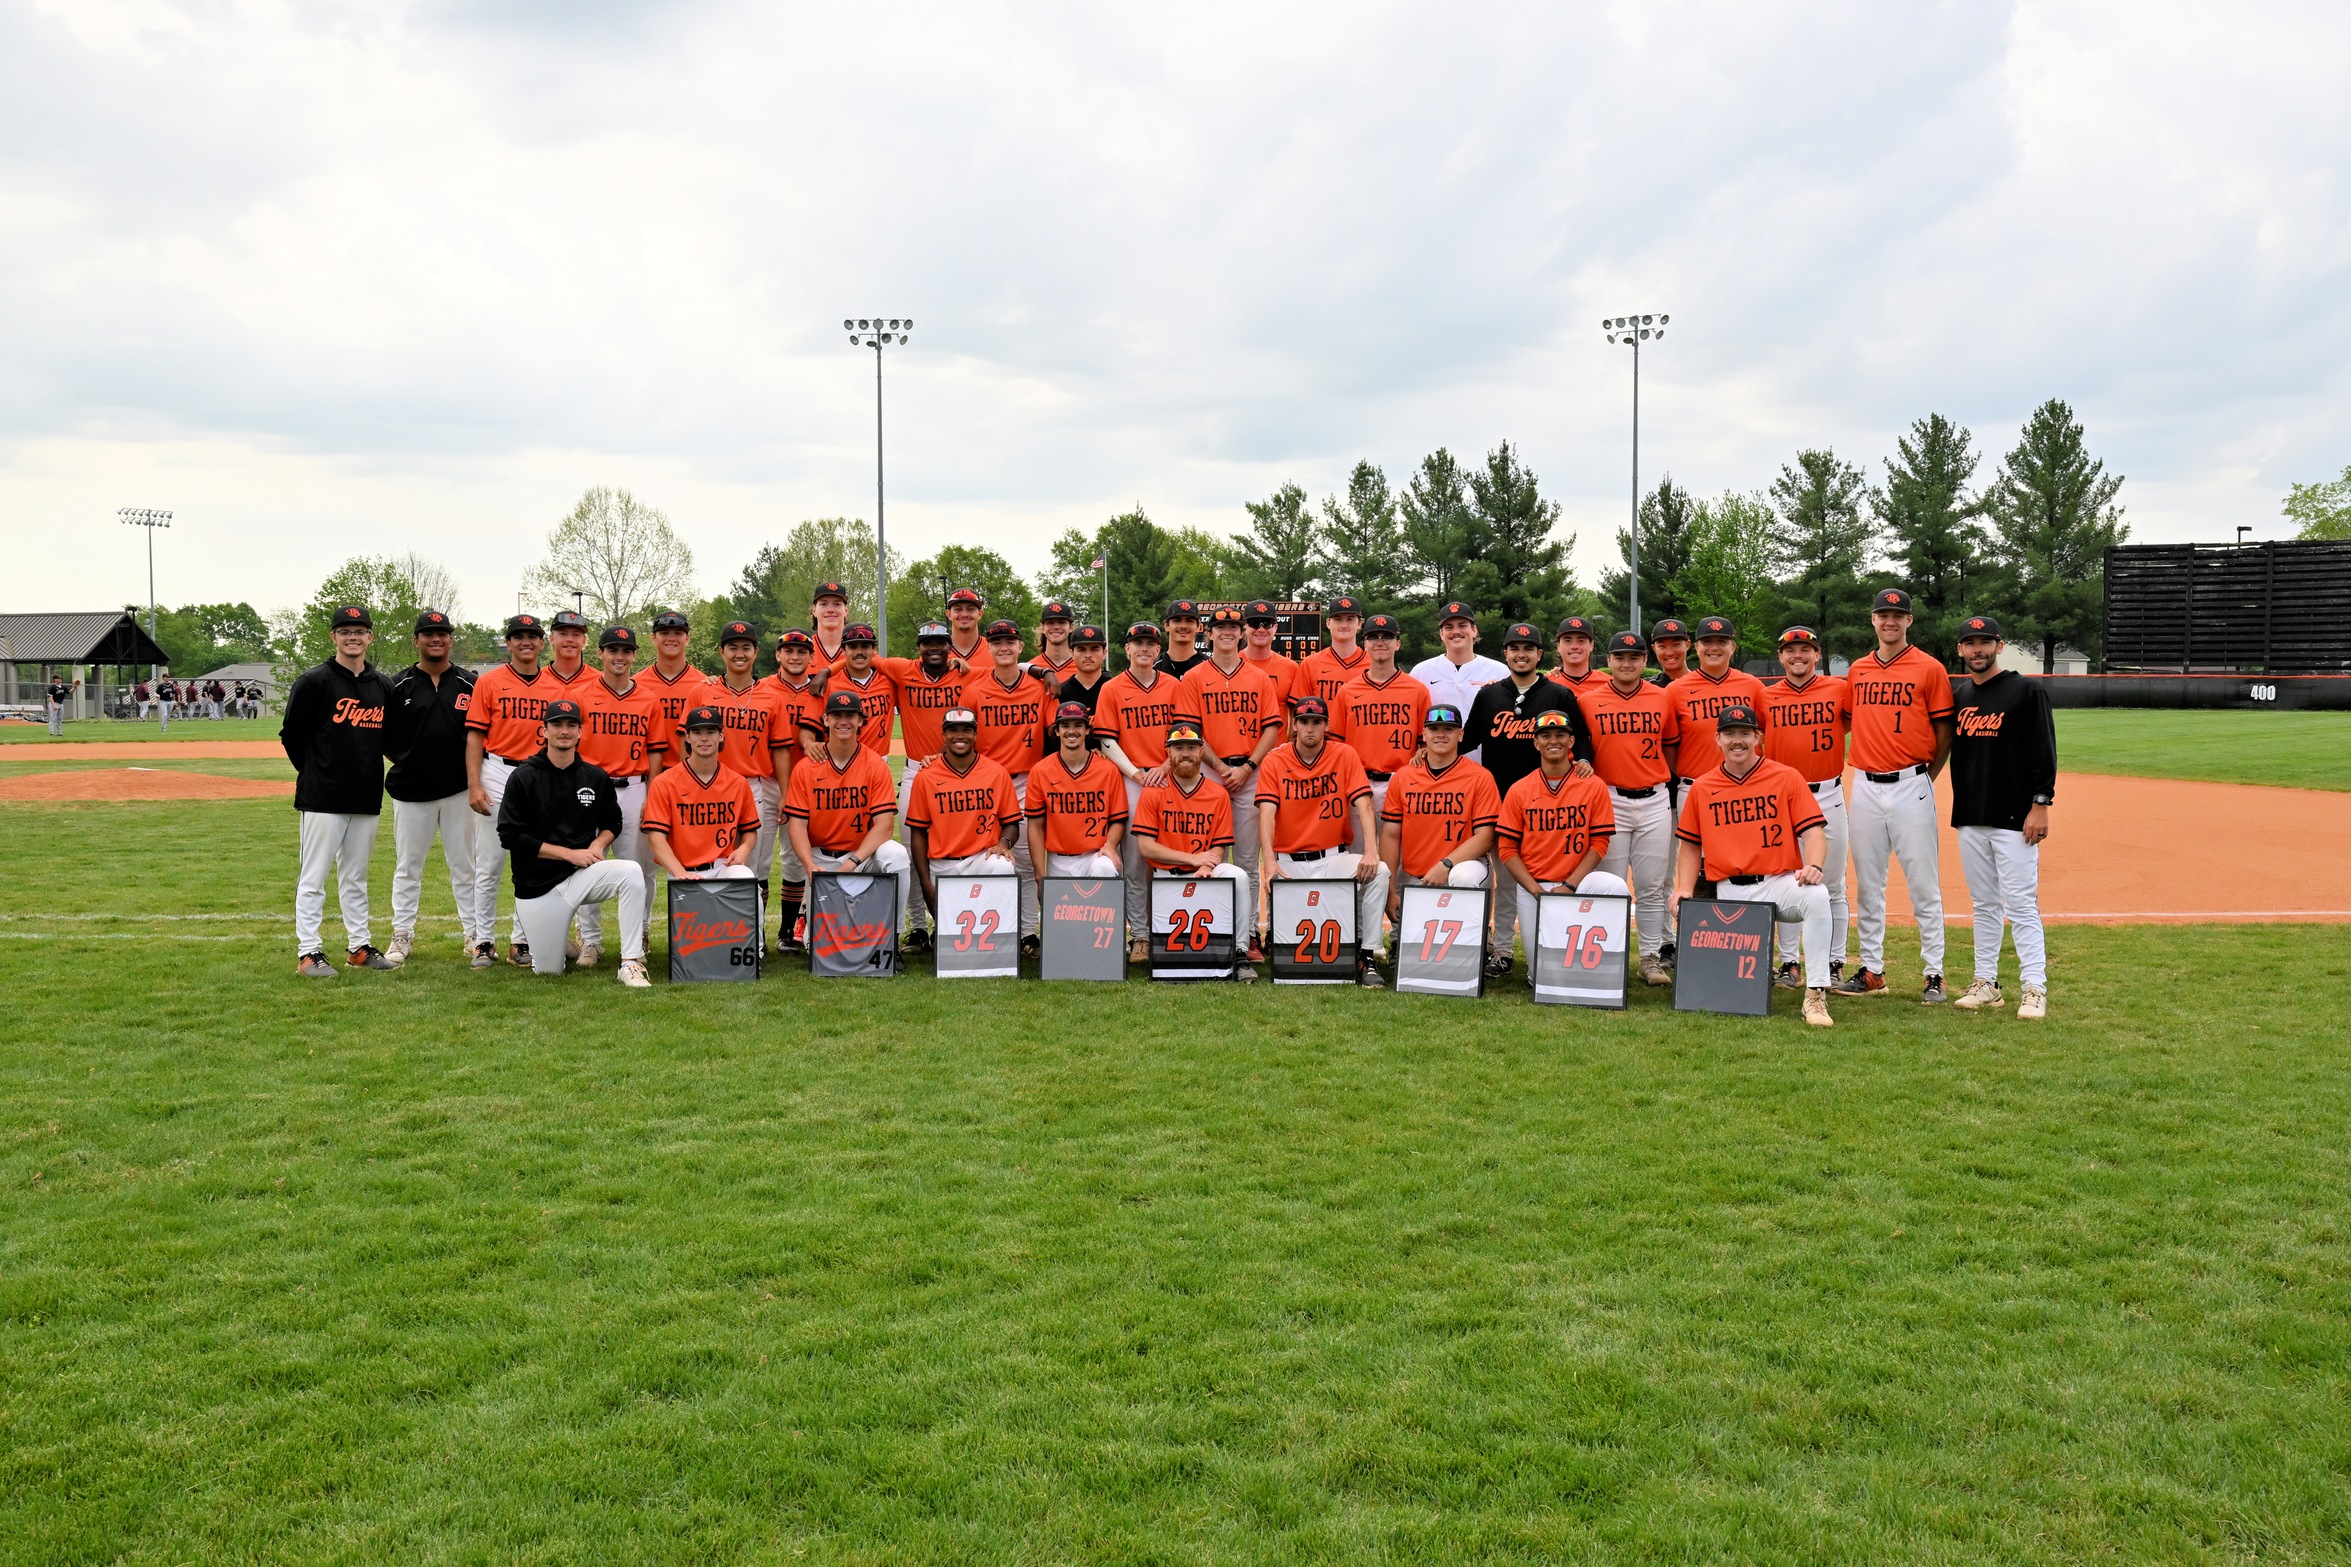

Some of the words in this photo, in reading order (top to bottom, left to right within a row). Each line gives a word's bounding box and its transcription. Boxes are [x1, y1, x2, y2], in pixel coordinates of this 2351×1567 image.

[455, 693, 471, 710] G
[905, 685, 963, 709] TIGERS
[1202, 691, 1259, 715] TIGERS
[1855, 681, 1916, 707] TIGERS
[2250, 685, 2276, 701] 400
[332, 697, 385, 727] Tigers
[498, 697, 549, 721] TIGER
[981, 703, 1039, 727] TIGERS
[1351, 703, 1411, 727] TIGERS
[1769, 701, 1835, 728] TIGERS
[589, 711, 648, 737] TIGERS
[1238, 716, 1258, 738] 34
[1490, 710, 1537, 739] Tiger
[1595, 711, 1662, 735] TIGERS
[1893, 710, 1903, 734] 1
[1956, 706, 2005, 737] Tigers
[749, 735, 760, 756] 7
[1022, 728, 1034, 748] 4
[1388, 729, 1412, 750] 40
[1641, 738, 1660, 760] 21
[1811, 728, 1834, 752] 15
[630, 741, 642, 760] 6
[813, 786, 869, 811] TIGERS
[1283, 772, 1338, 801] TIGERS
[676, 801, 736, 826] TIGERS
[935, 788, 995, 815] TIGERS
[1047, 791, 1105, 814] TIGERS
[1319, 798, 1344, 820] 20
[1406, 792, 1465, 815] TIGERS
[1709, 795, 1778, 826] TIGERS
[976, 814, 997, 835] 32
[1085, 817, 1108, 837] 27
[1162, 810, 1214, 835] TIGERS
[1525, 804, 1587, 832] TIGERS
[1444, 819, 1467, 842] 17
[1759, 824, 1783, 848] 12
[1563, 832, 1585, 855] 16
[969, 883, 983, 899] G
[1182, 882, 1197, 898] G
[1306, 890, 1320, 907] G
[1437, 893, 1452, 908] G
[1053, 904, 1117, 924] GEORGETOWN
[1578, 899, 1594, 914] G
[672, 911, 753, 948] Tigers
[813, 912, 891, 949] Tigers
[953, 909, 1000, 952] 32
[1093, 927, 1115, 949] 27
[1165, 908, 1214, 952] 26
[1294, 919, 1342, 964] 20
[1418, 919, 1464, 962] 17
[1690, 930, 1761, 952] GEORGETOWN
[729, 947, 755, 966] 66
[1562, 924, 1608, 970] 16
[868, 950, 893, 970] 47
[1737, 955, 1757, 979] 12
